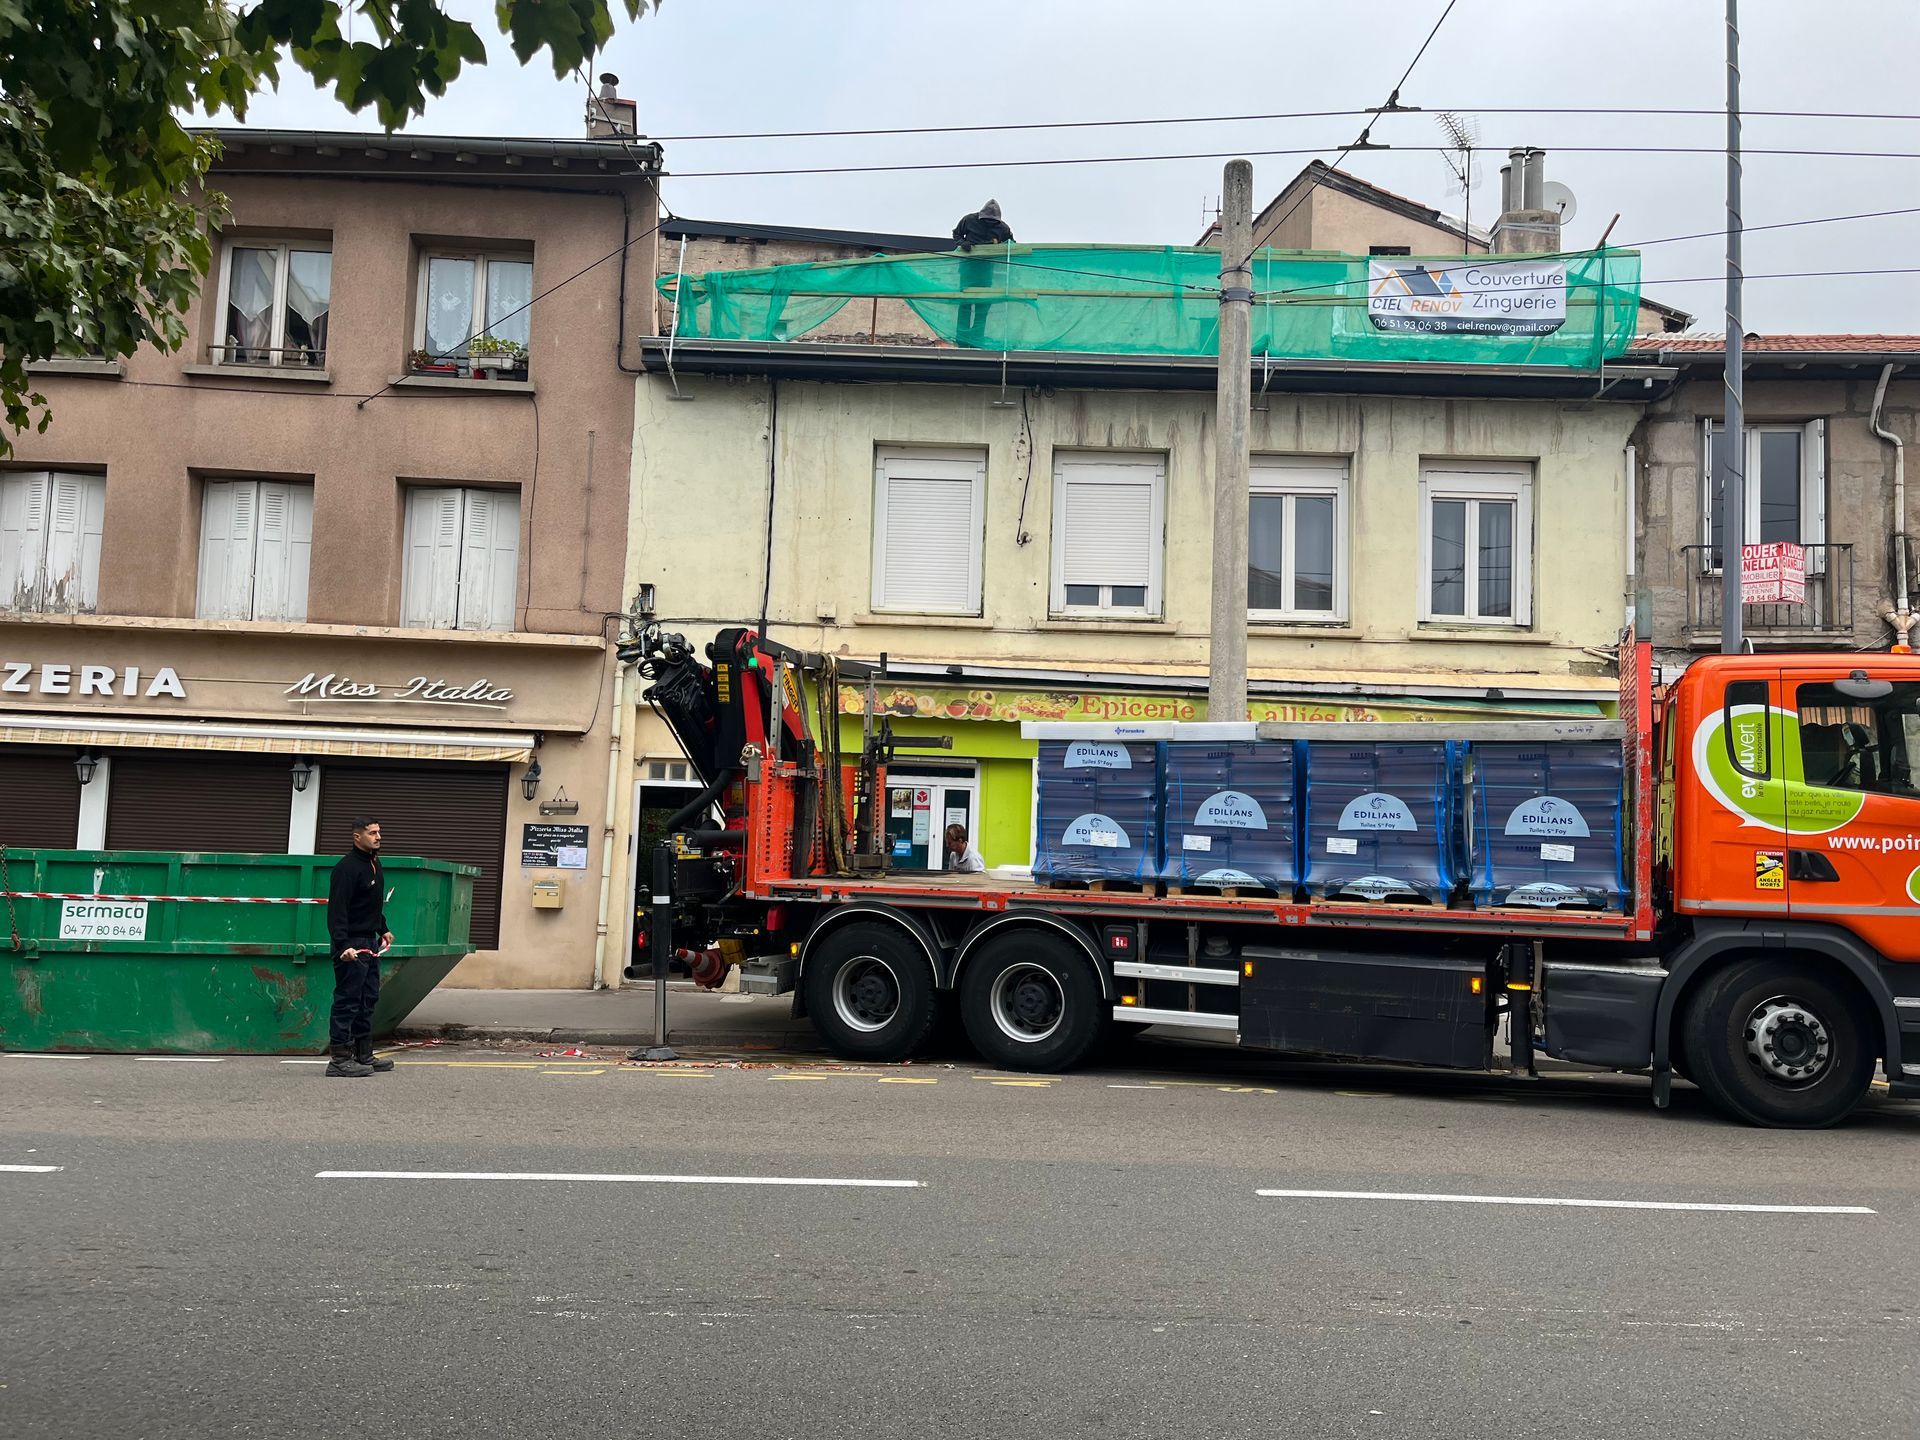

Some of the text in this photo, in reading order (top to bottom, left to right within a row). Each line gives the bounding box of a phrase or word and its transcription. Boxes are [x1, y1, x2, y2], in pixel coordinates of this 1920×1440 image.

[1465, 269, 1564, 287] Couverture
[1372, 298, 1464, 313] CIEL RENOV
[1472, 293, 1557, 313] Zinguerie
[1374, 318, 1447, 331] 06 51 93 06 38
[1457, 321, 1559, 335] ciel.renov@gmail.com
[1742, 545, 1778, 559] OUER
[1, 662, 187, 698] ZERIA
[283, 672, 514, 701] Miss Italia
[1080, 694, 1195, 721] Epicerie
[1264, 705, 1337, 721] alliés
[1076, 748, 1119, 758] EDILIANS
[1737, 723, 1757, 799] evluvert
[1208, 807, 1253, 818] EDILIANS
[1353, 810, 1402, 820] EDILIANS
[1522, 815, 1573, 825] EDILIANS
[1555, 828, 1567, 836] Foy
[65, 905, 145, 919] sermaco
[64, 924, 142, 936] 04 77 80 64 64
